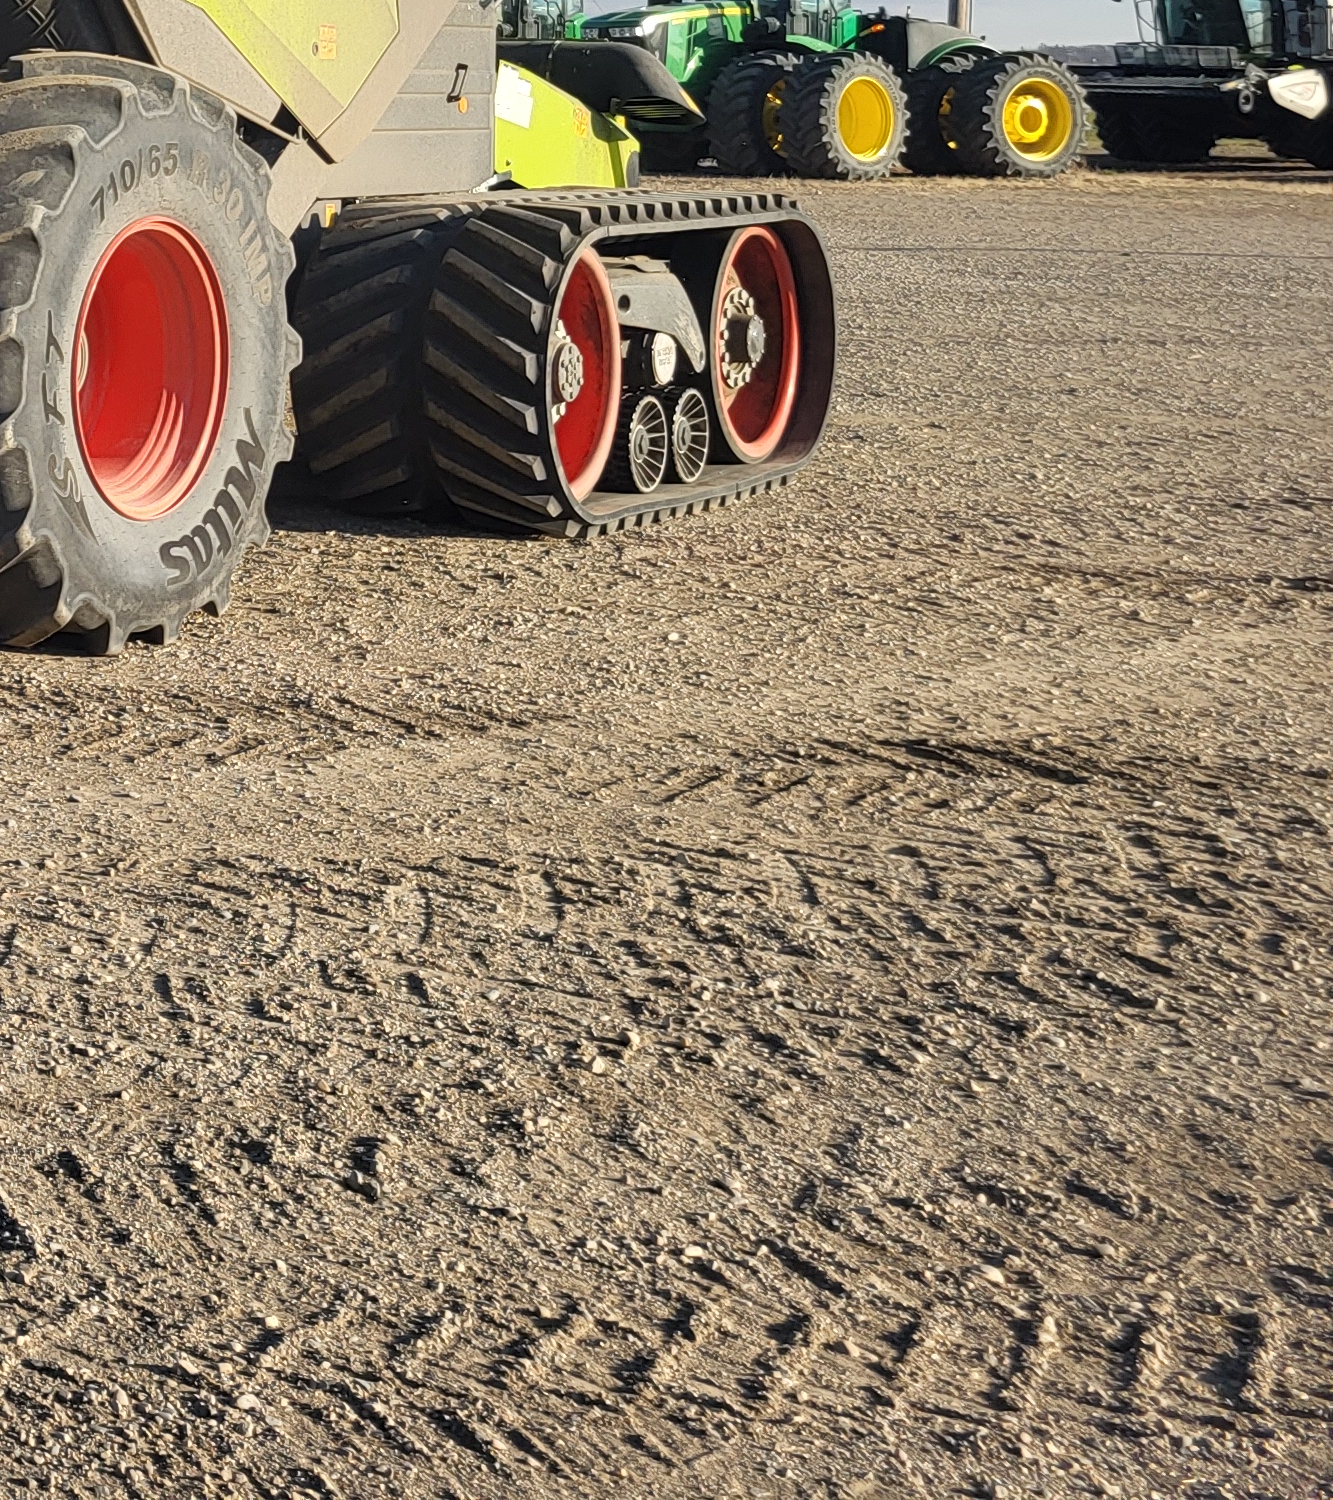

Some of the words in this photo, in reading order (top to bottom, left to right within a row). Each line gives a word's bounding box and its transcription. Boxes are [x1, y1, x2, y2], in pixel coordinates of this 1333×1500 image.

[89, 142, 179, 227] 710/65
[186, 150, 210, 190] R
[212, 169, 246, 223] 30
[159, 406, 265, 588] Mitas
